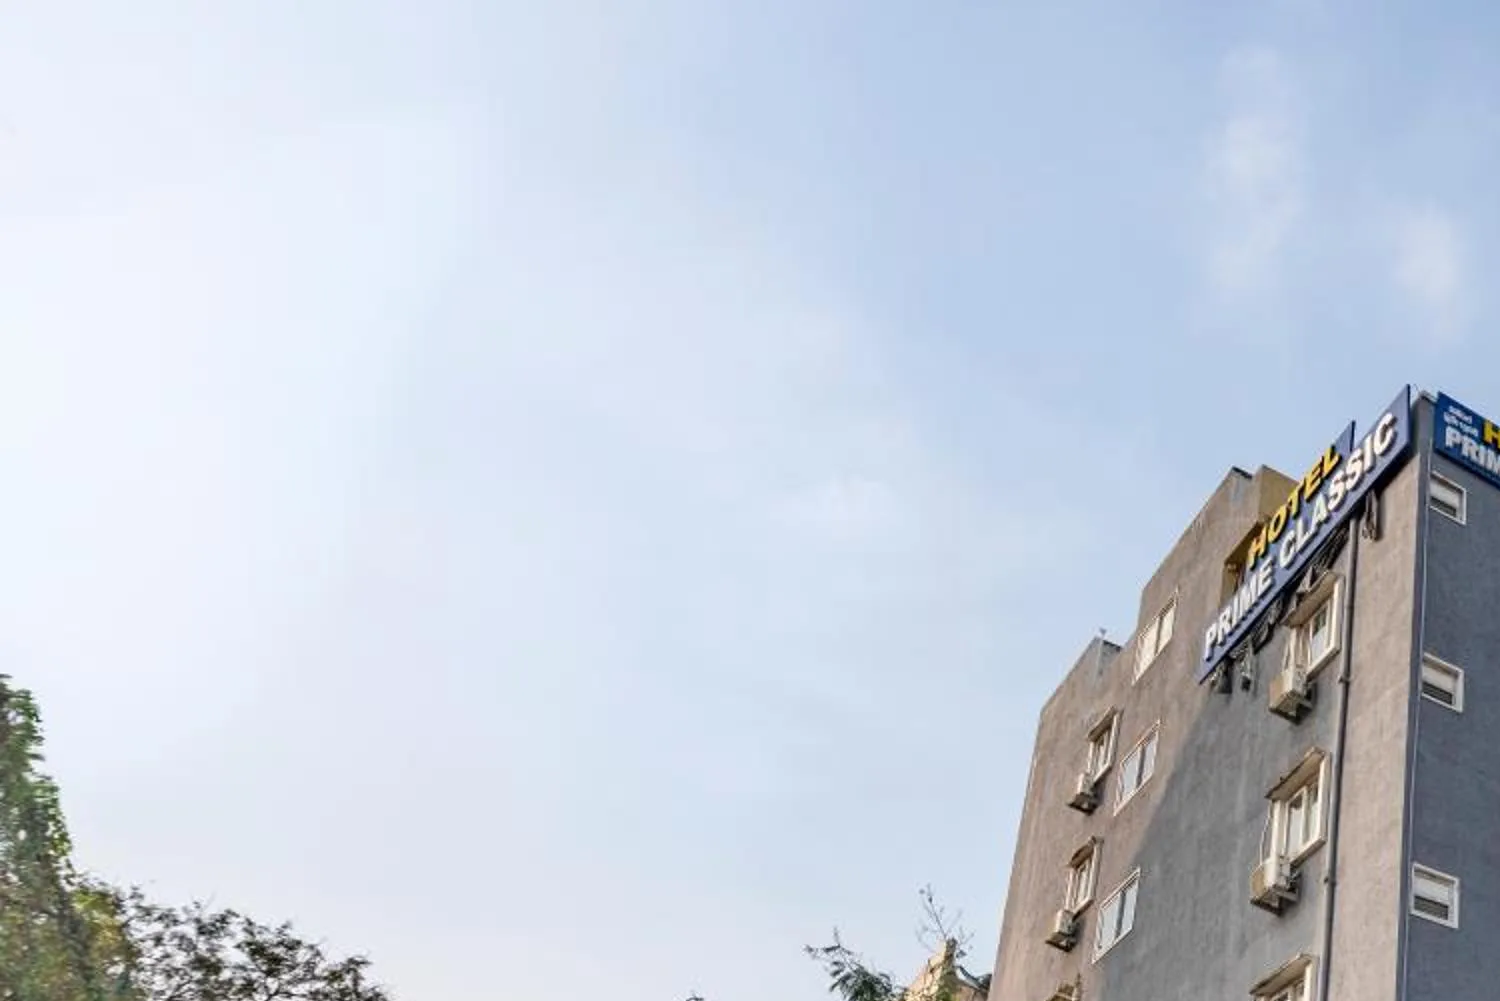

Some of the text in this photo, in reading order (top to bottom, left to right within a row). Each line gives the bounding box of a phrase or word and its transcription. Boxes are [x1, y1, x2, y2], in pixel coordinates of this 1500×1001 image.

[1204, 411, 1399, 663] PRIME CLASSIC
[1246, 443, 1342, 572] HOTEL
